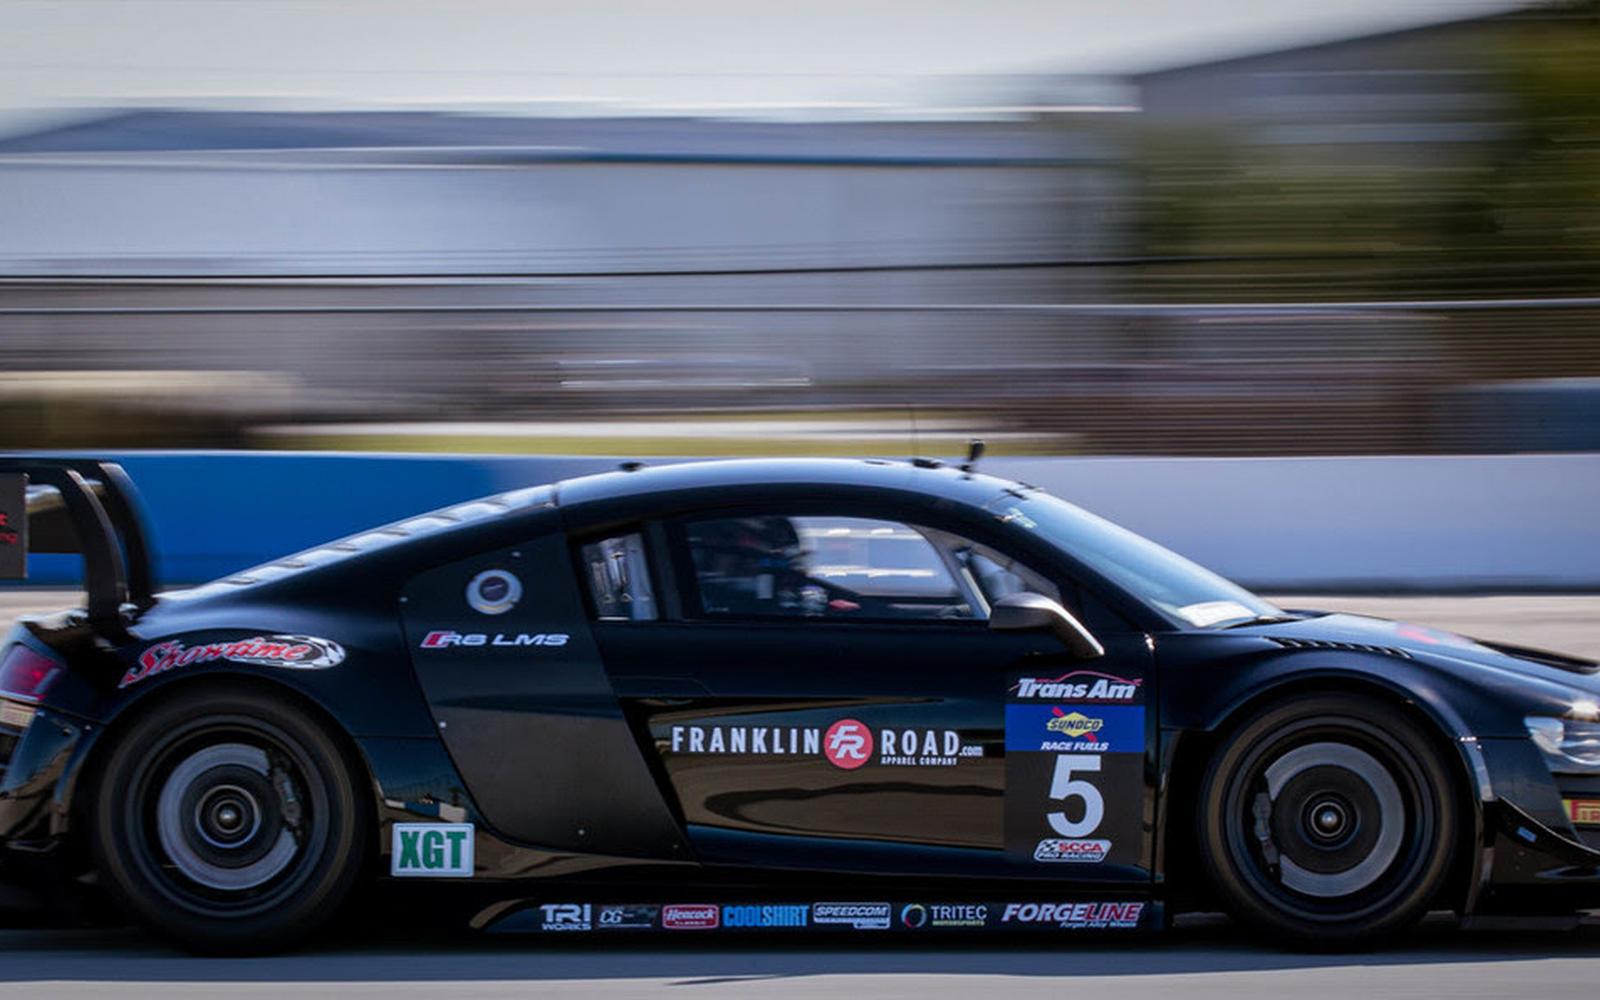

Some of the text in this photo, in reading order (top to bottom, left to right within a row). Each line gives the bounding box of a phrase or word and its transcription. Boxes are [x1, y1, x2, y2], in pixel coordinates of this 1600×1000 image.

[492, 633, 569, 646] LMS
[118, 637, 313, 688] Showtime
[1049, 718, 1101, 731] SUNOCO
[671, 726, 820, 754] FRANKLIN
[1041, 741, 1109, 751] RACE FUELS
[880, 756, 958, 766] APPAREL COMPANY
[1047, 754, 1104, 838] 5
[400, 831, 467, 869] XGT
[1059, 842, 1103, 852] SCCA
[540, 904, 592, 922] TRI
[723, 905, 809, 927] COOLSHIRT
[816, 906, 888, 916] SPEEDCOM
[931, 906, 987, 919] TRITEC
[1002, 903, 1144, 921] FORGELINE
